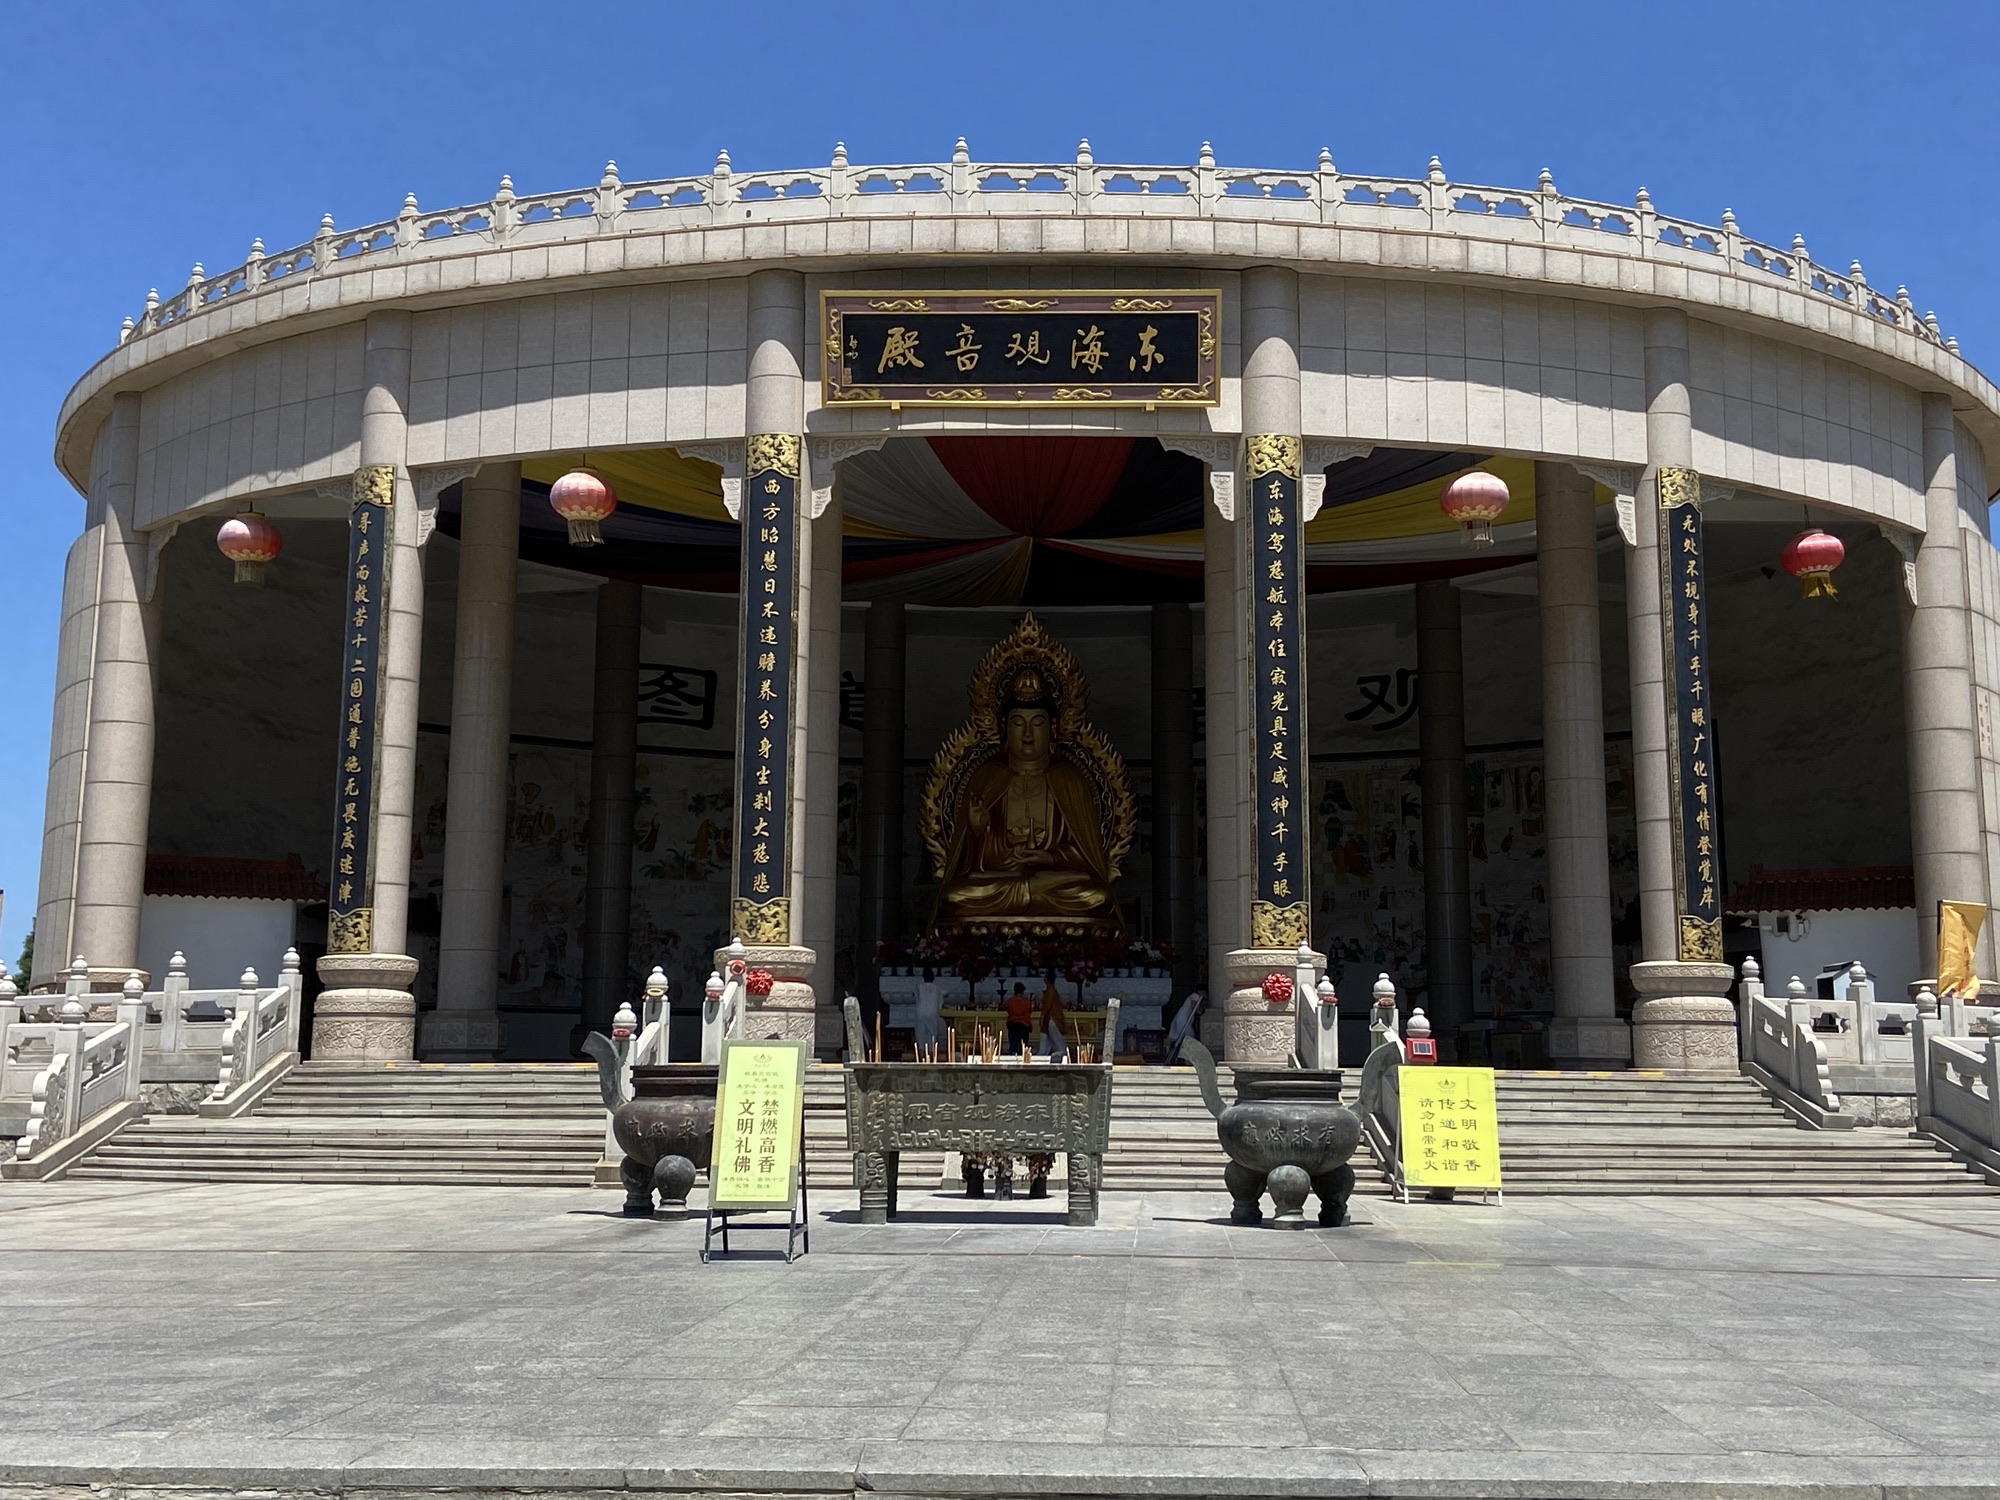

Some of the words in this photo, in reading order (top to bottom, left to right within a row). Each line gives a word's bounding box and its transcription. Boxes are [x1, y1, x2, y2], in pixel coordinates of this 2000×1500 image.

[877, 322, 1165, 375] 东海观音殿
[733, 1098, 756, 1174] 文明礼佛
[757, 1098, 780, 1173] 禁燃高香
[1418, 1097, 1439, 1171] 请勿自带香火
[1438, 1098, 1460, 1171] 传递和谐
[1459, 1098, 1481, 1172] 文明敬香
